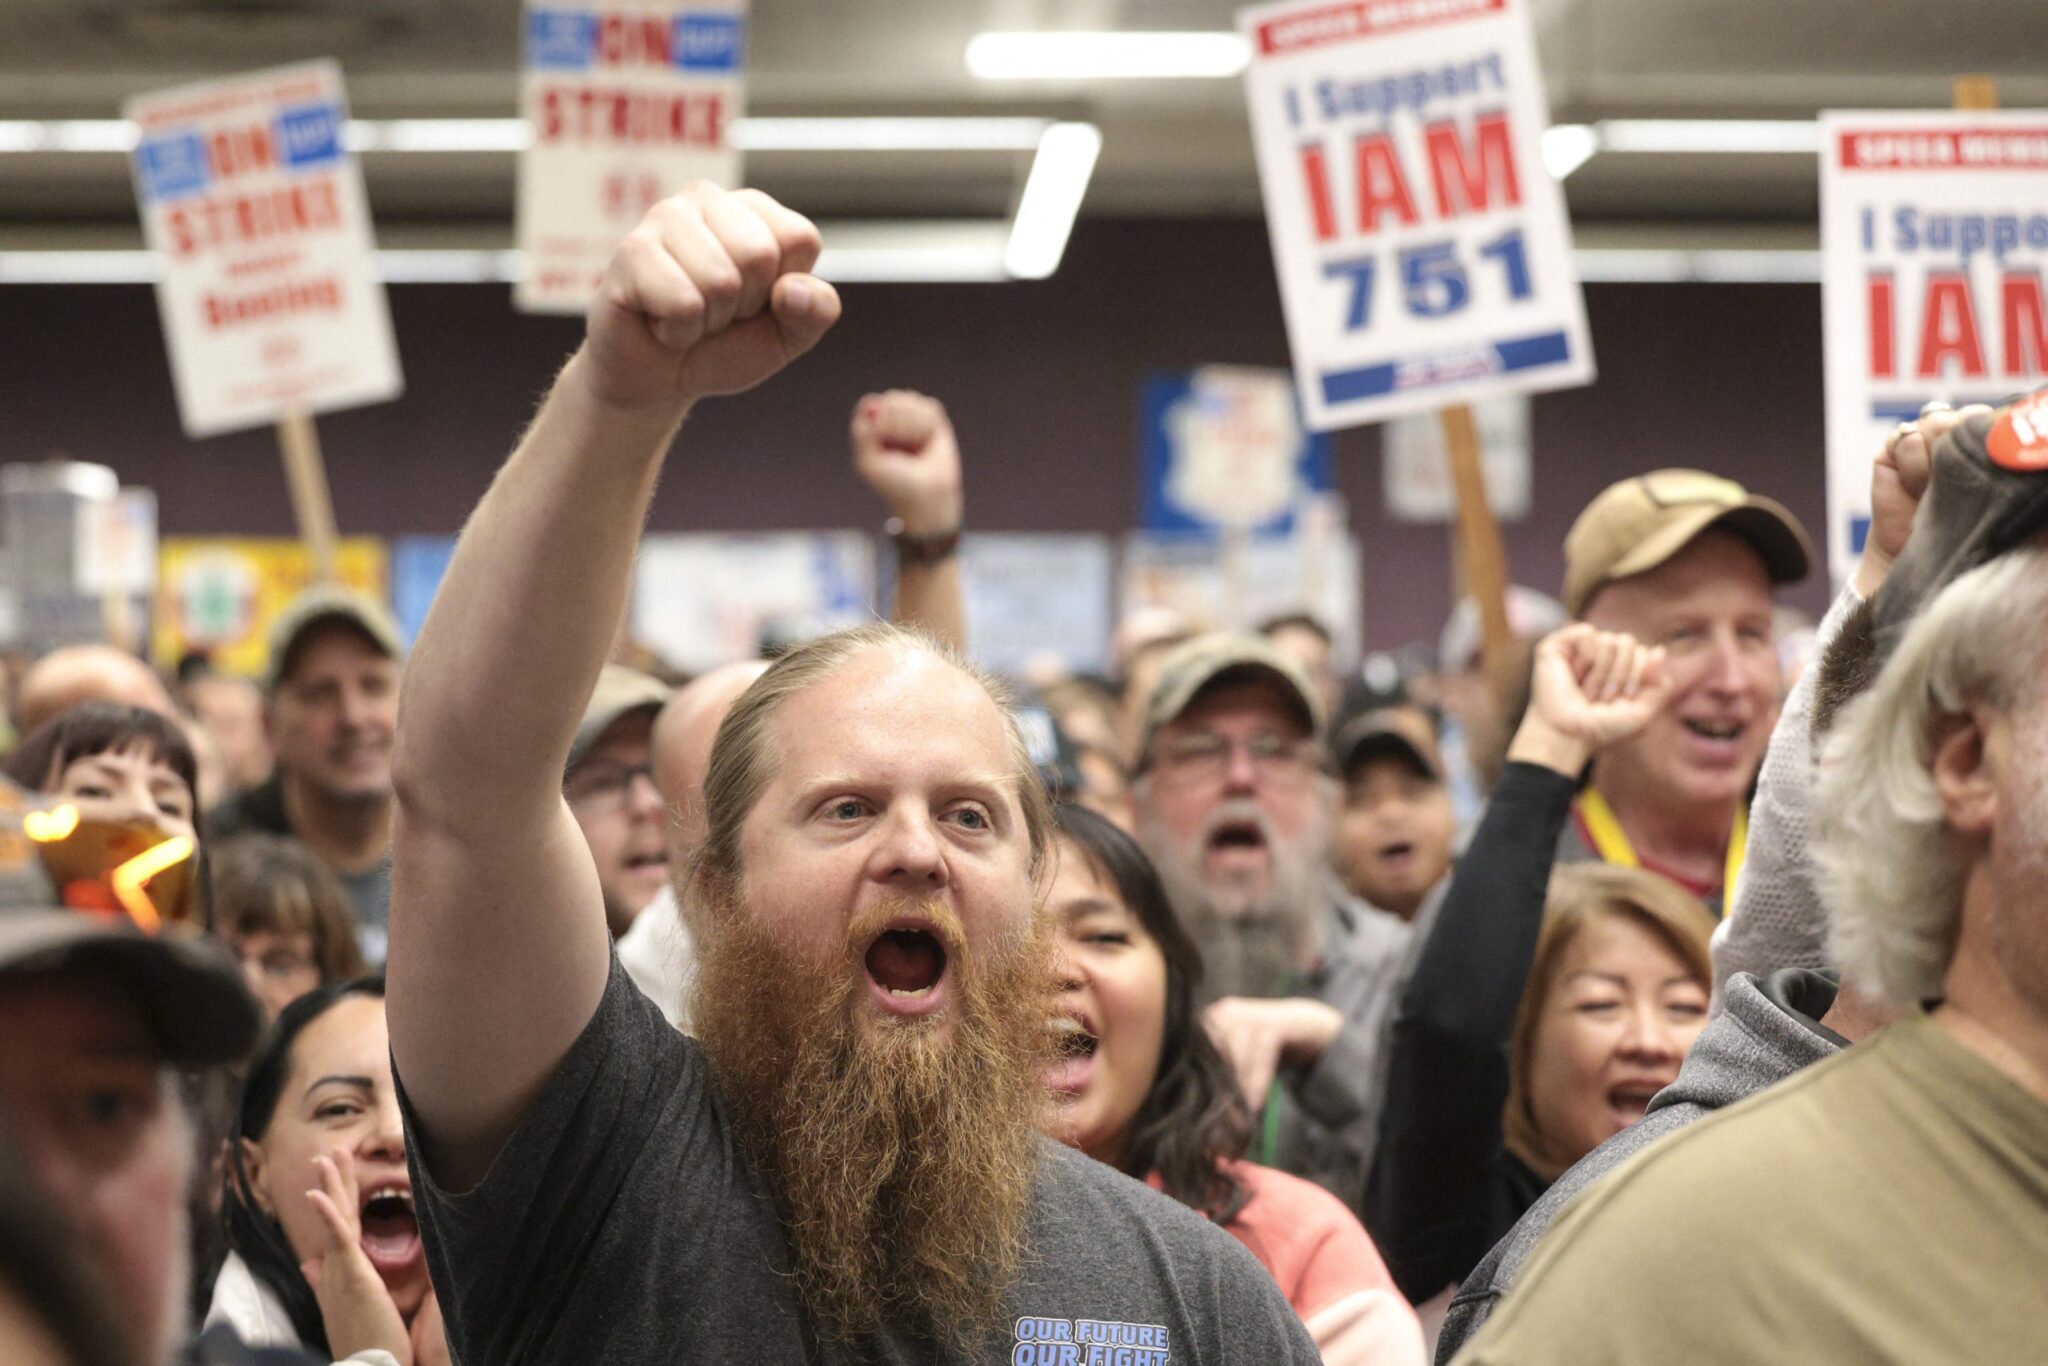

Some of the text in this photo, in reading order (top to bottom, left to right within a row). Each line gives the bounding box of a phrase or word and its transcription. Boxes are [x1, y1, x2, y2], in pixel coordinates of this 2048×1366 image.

[602, 16, 672, 65] ON
[1284, 53, 1506, 124] I Support
[542, 88, 722, 149] STRIKE
[211, 126, 273, 179] ON
[1300, 111, 1525, 242] IAM
[168, 179, 342, 257] STRIKE
[1860, 206, 1875, 252] I
[1321, 230, 1534, 335] 751
[1013, 1341, 1170, 1366] OUR FIGHT
[1016, 1317, 1169, 1348] OUR FUTURE
